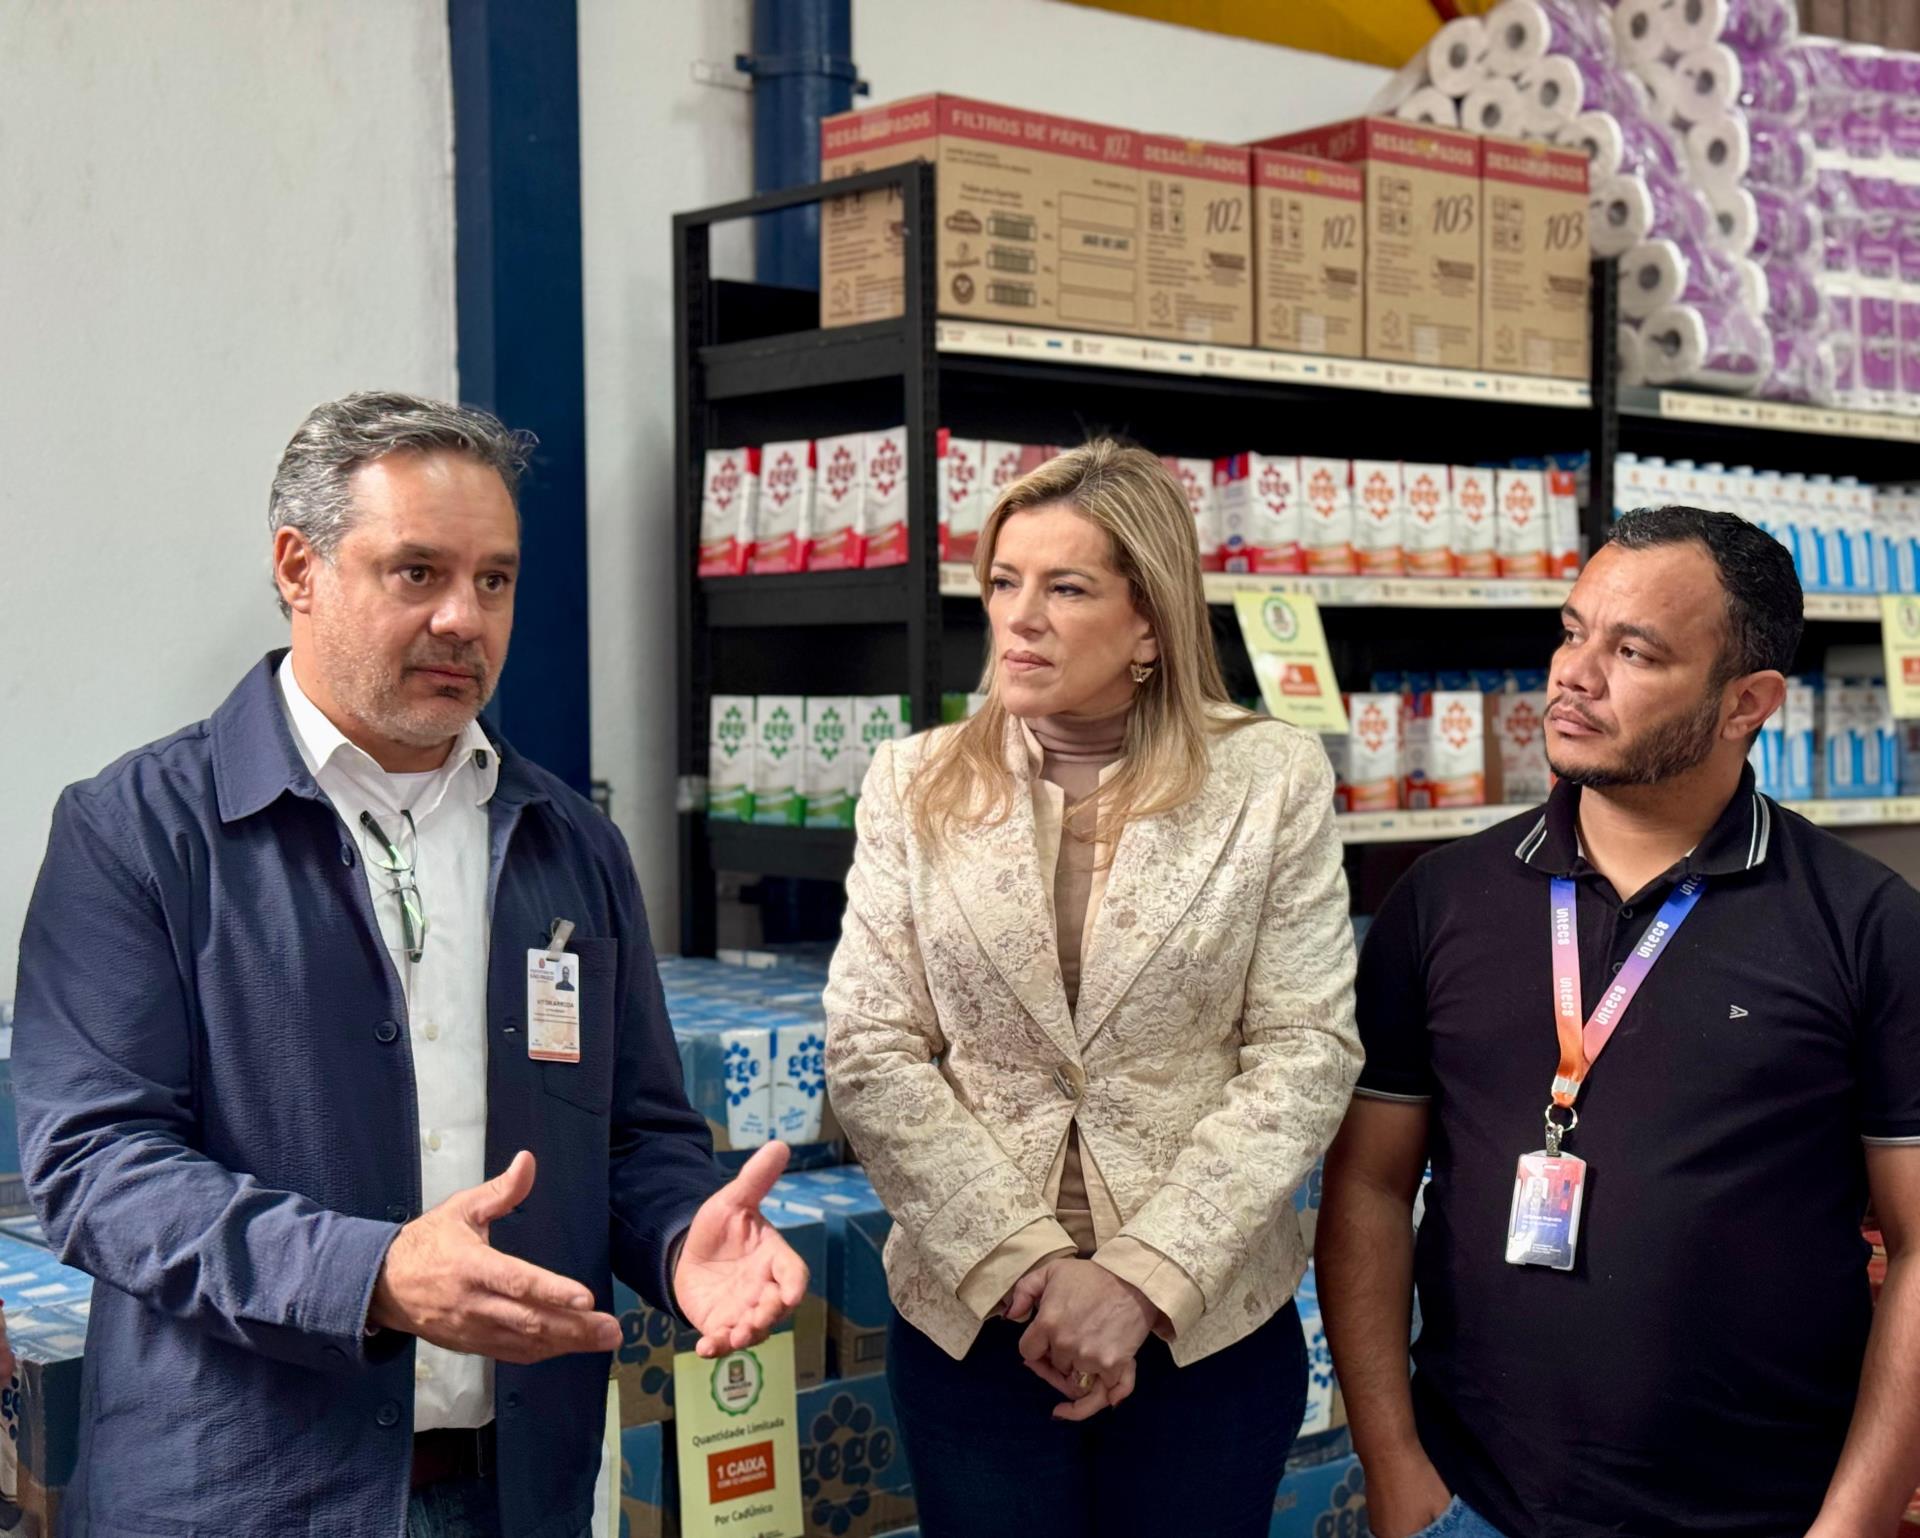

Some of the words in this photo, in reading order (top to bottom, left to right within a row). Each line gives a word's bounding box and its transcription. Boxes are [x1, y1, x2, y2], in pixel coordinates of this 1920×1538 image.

[952, 109, 1020, 136] FILTROS
[1024, 121, 1046, 141] DE
[1050, 127, 1098, 152] PAPEL
[1204, 199, 1243, 236] 102
[1321, 214, 1357, 250] 102
[1432, 194, 1474, 236] 103
[1543, 211, 1585, 251] 103
[692, 1426, 745, 1447] Quantidade
[748, 1418, 784, 1434] Limitada
[716, 1465, 725, 1480] 1
[726, 1455, 768, 1477] CAIXA
[714, 1513, 730, 1526] Por
